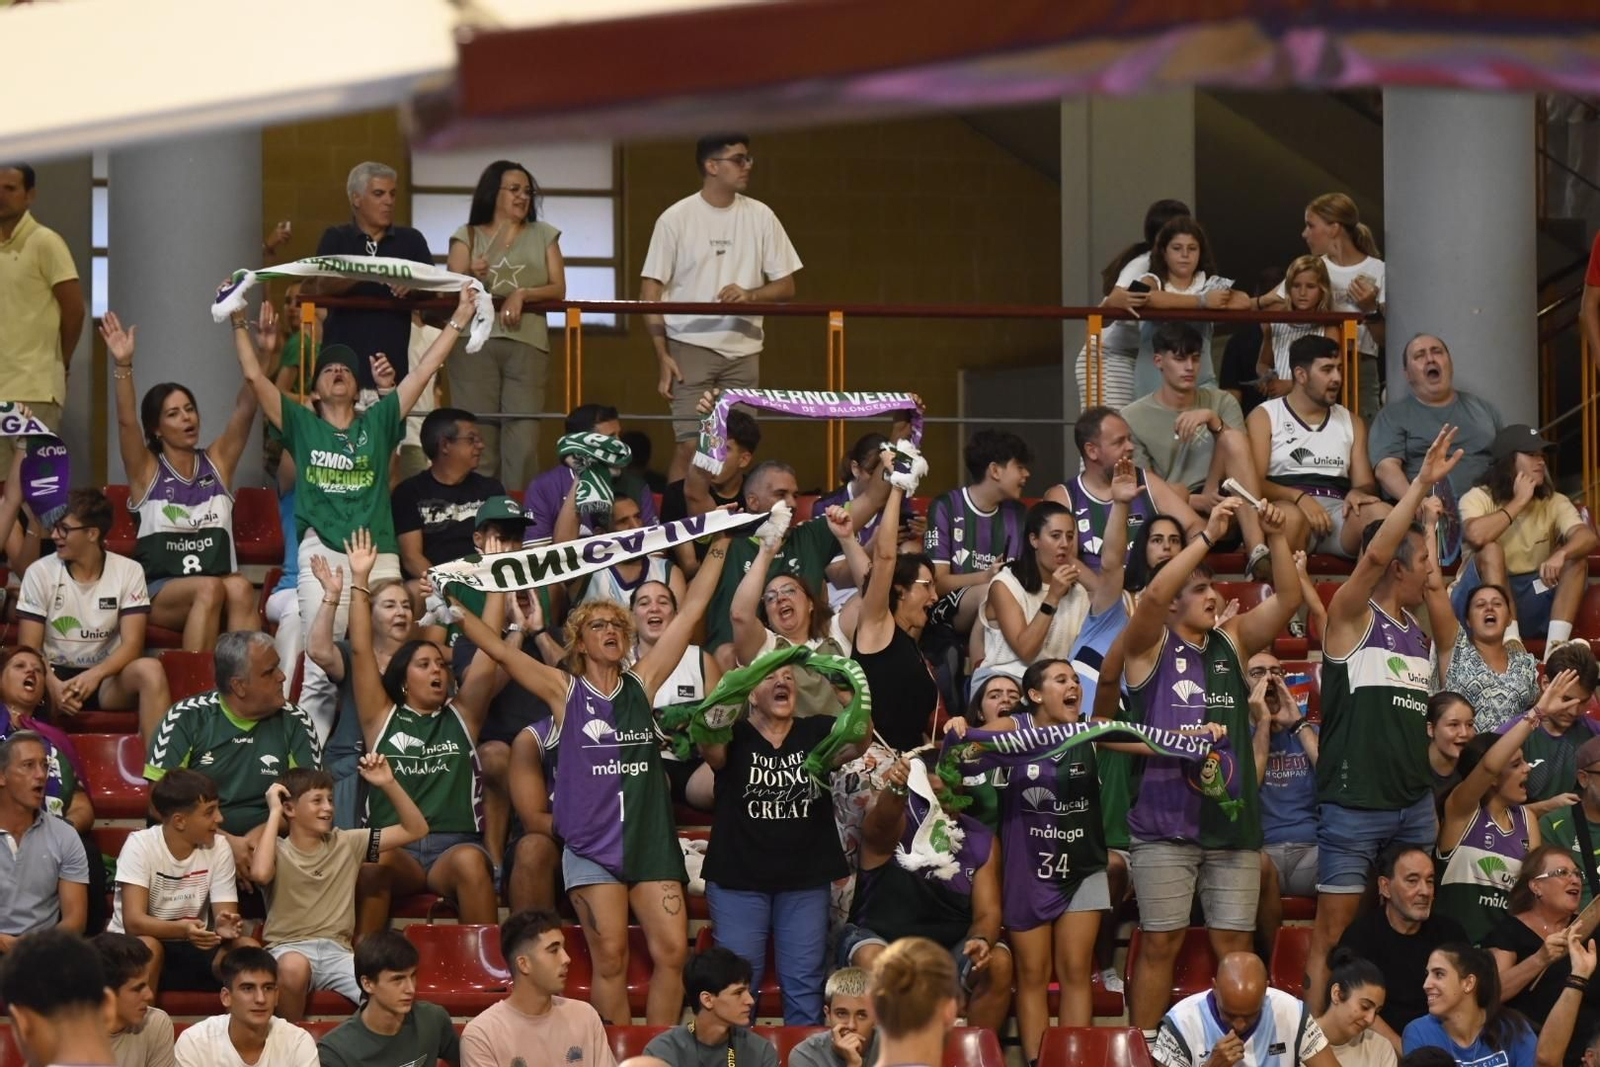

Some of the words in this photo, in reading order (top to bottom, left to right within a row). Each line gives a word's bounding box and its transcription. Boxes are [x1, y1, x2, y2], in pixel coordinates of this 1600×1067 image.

[843, 391, 915, 406] VERD
[1313, 456, 1344, 467] Unicaja
[166, 537, 213, 552] málaga
[182, 554, 202, 575] 8
[1393, 694, 1428, 716] málag
[614, 727, 653, 742] Unicaja
[992, 721, 1090, 754] UNICAJA
[1097, 720, 1213, 755] BALONCEST
[592, 758, 649, 776] málaga
[749, 765, 809, 788] DOING
[617, 790, 625, 822] 1
[747, 799, 813, 820] GREAT
[1030, 823, 1084, 842] málaga
[1037, 852, 1070, 879] 34
